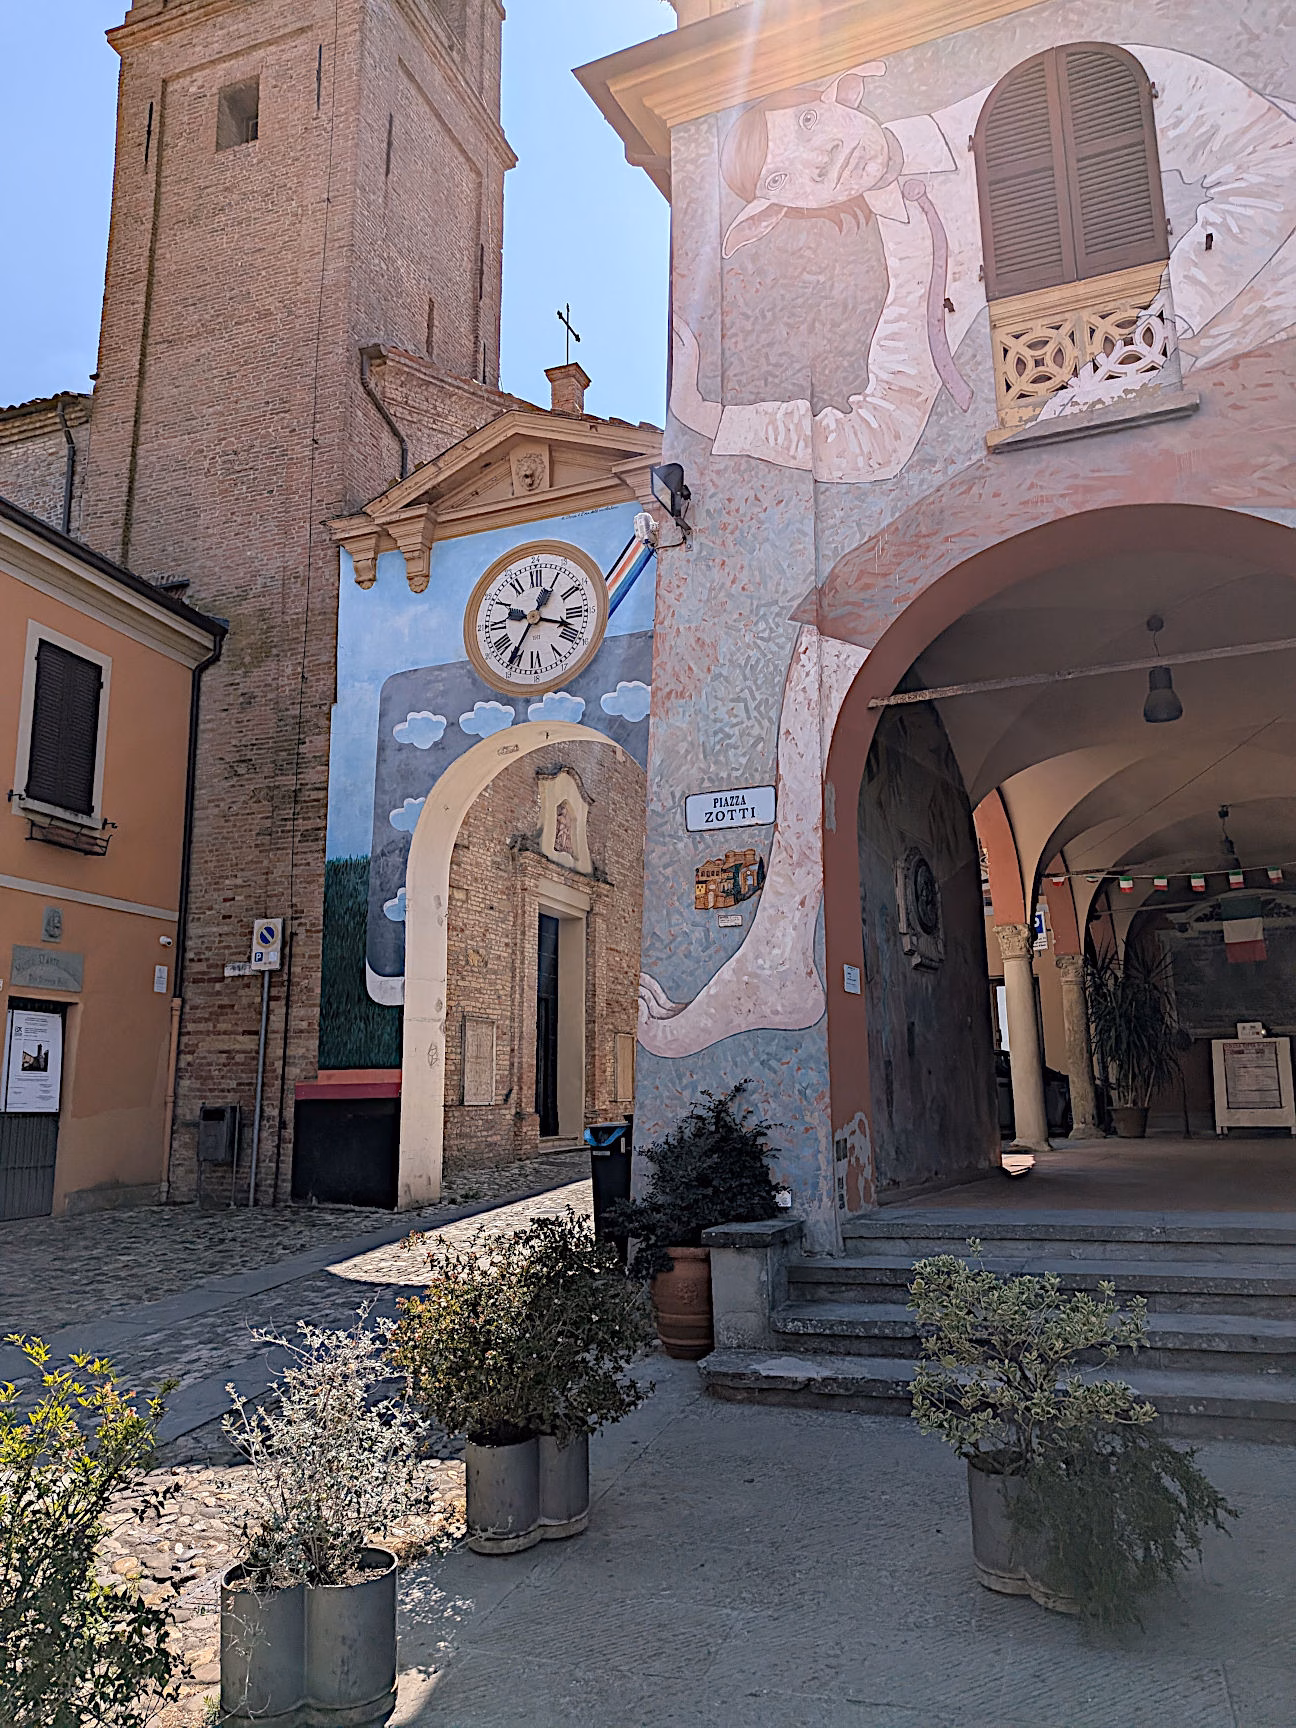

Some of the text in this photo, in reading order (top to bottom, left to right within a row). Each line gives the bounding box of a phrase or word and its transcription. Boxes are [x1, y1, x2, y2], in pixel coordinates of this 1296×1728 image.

[531, 555, 540, 563] 24
[530, 569, 543, 589] XII
[509, 577, 525, 598] XI
[560, 585, 580, 603] II
[566, 605, 583, 619] III
[589, 606, 596, 614] 15
[490, 618, 507, 632] IX
[494, 633, 512, 655] VIII
[530, 650, 542, 668] VI
[562, 663, 569, 671] 17
[533, 675, 540, 683] 18
[713, 794, 746, 809] PIAZZA
[704, 806, 756, 824] ZOTTI
